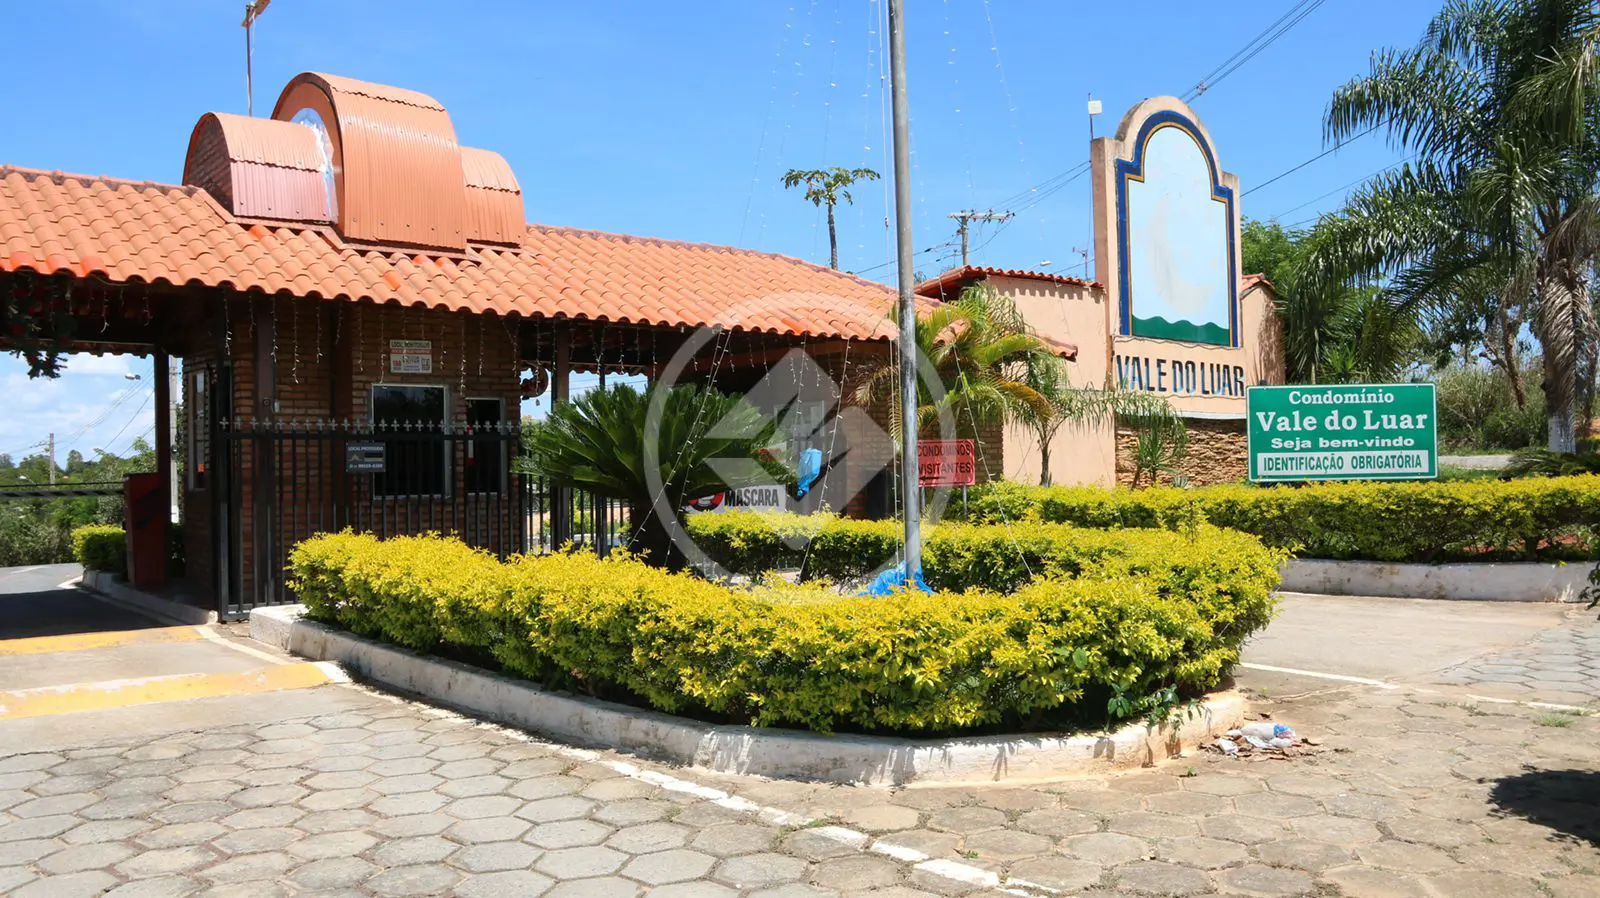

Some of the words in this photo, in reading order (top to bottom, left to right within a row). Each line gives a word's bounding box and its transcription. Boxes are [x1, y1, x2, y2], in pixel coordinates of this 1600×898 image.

[1116, 355, 1167, 392] VALE
[1172, 360, 1196, 394] DO
[1200, 362, 1245, 397] LUAR
[1288, 388, 1395, 404] Condomínio
[1256, 410, 1317, 432] Vale
[1324, 409, 1357, 431] do
[1363, 410, 1428, 430] Luar
[1271, 437, 1312, 451] Seja
[1319, 436, 1415, 448] bem-vindo
[918, 462, 971, 474] VISITANTES
[1264, 453, 1344, 473] IDENTIFICAÇÃO
[1351, 451, 1422, 470] OBRIGATÓRIA
